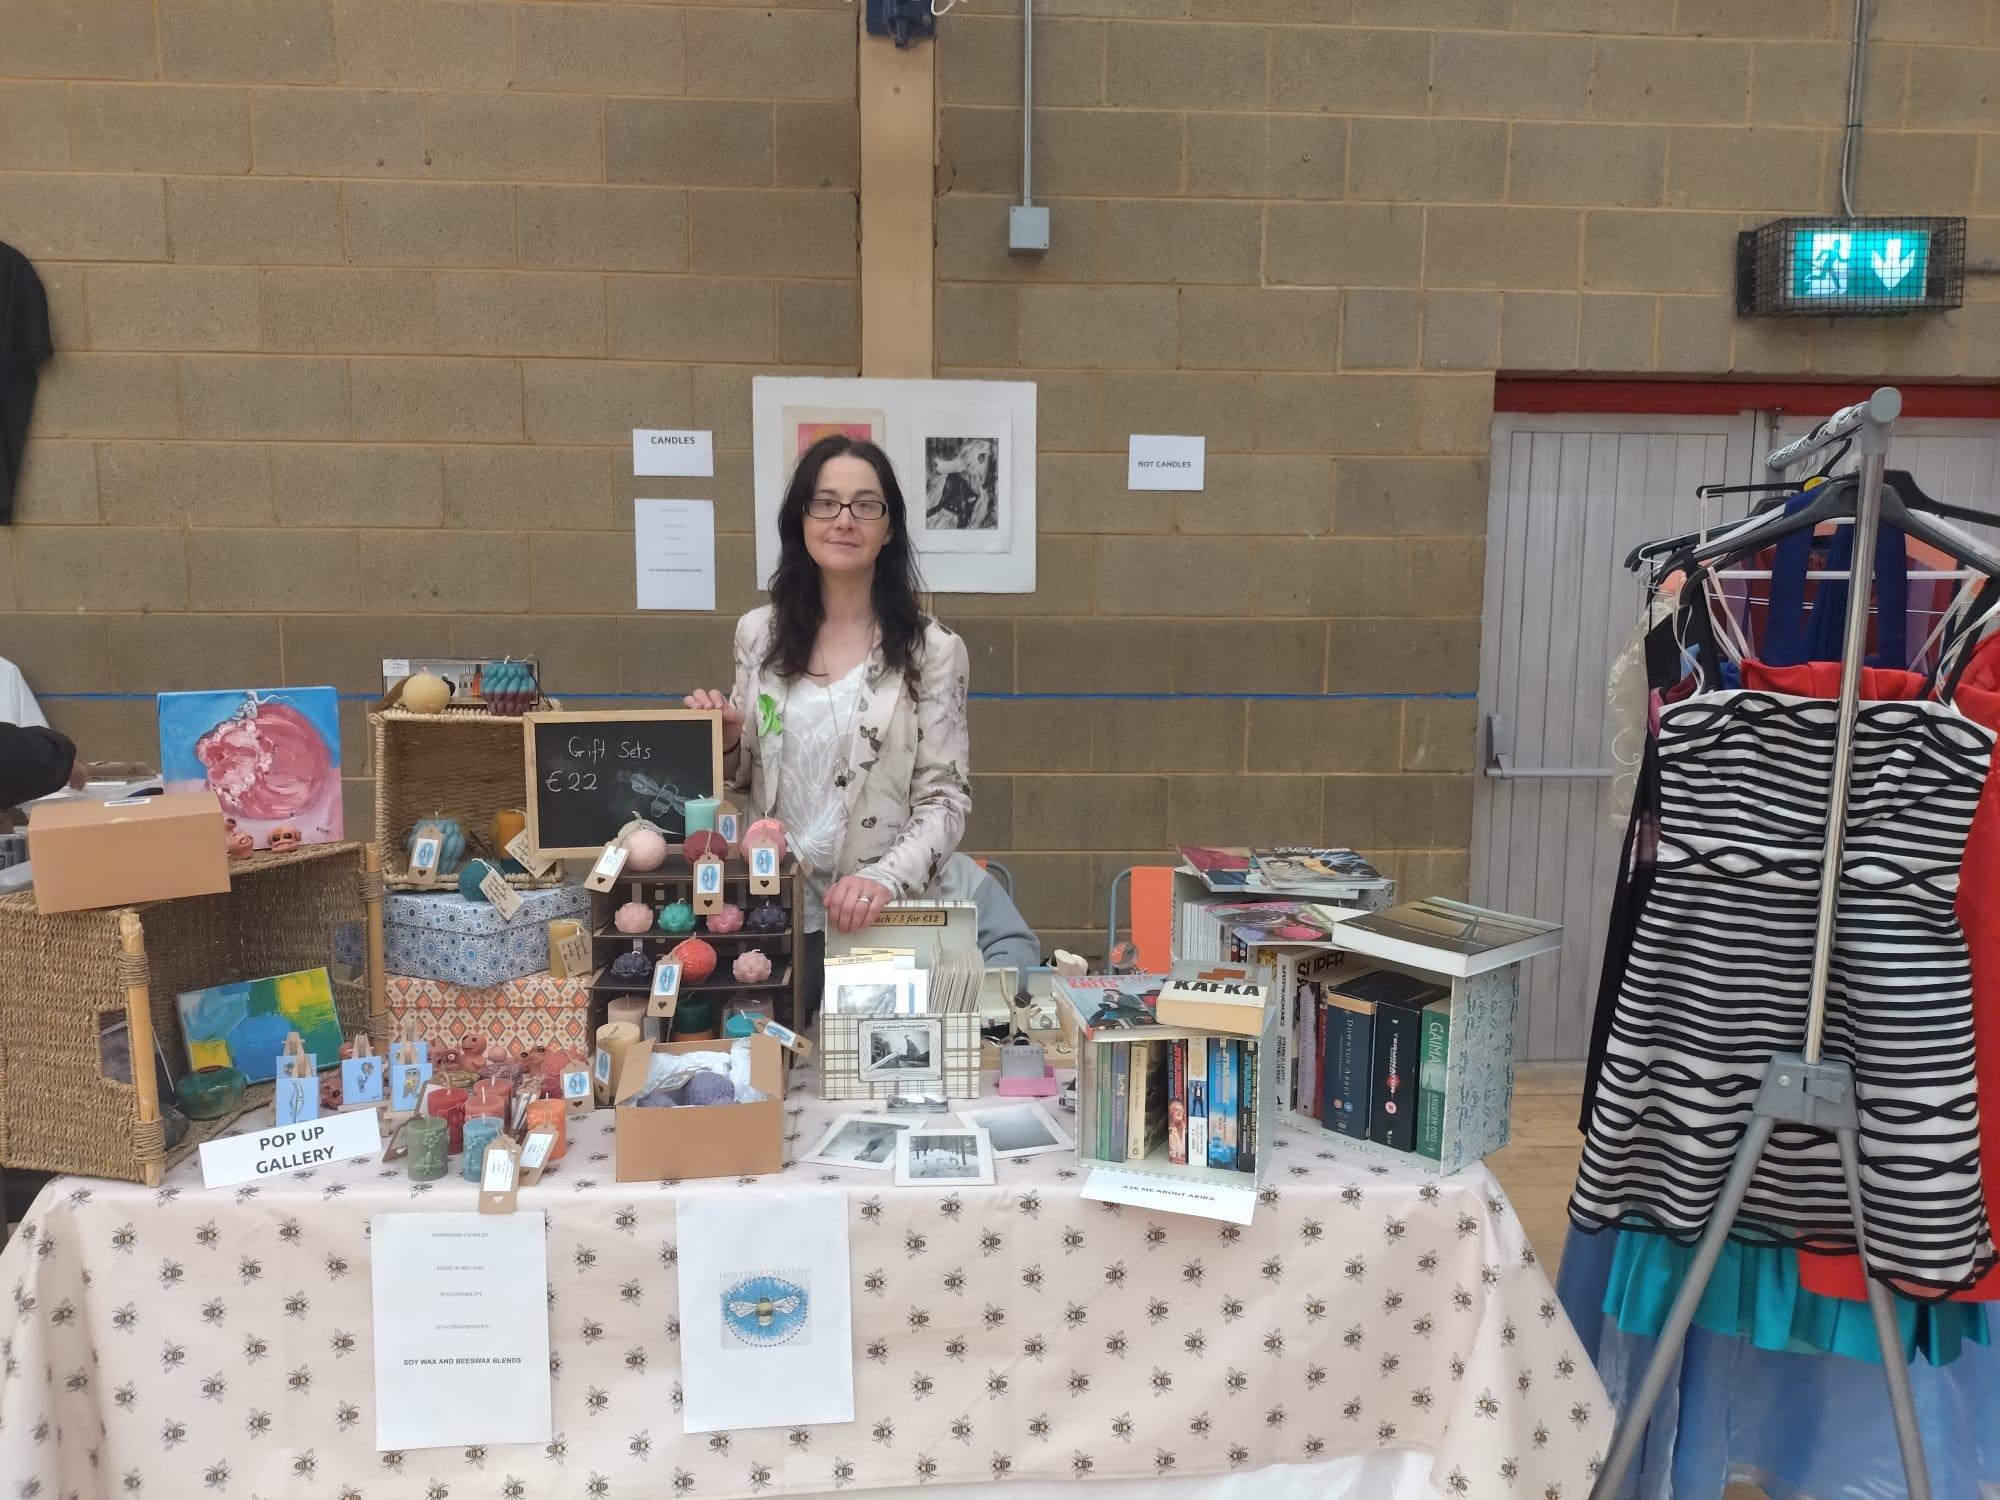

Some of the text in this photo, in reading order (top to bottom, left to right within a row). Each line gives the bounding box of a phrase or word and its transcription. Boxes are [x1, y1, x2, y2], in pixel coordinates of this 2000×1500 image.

[650, 435, 696, 445] CANDLES
[1137, 460, 1192, 469] NOT CANDLES
[568, 736, 652, 765] Gift Sets
[545, 770, 598, 793] €22
[874, 914, 891, 923] ach
[905, 914, 921, 925] for
[1172, 979, 1261, 997] KAFKA
[1343, 1019, 1354, 1100] DOWNTON ABBEY
[1390, 1032, 1399, 1094] TERMINATOR
[1430, 1093, 1439, 1126] AMERICAN
[259, 1126, 324, 1151] POP UP
[255, 1145, 334, 1174] GALLERY
[1156, 1188, 1186, 1197] ABOUT
[1188, 1193, 1216, 1201] AKIRA
